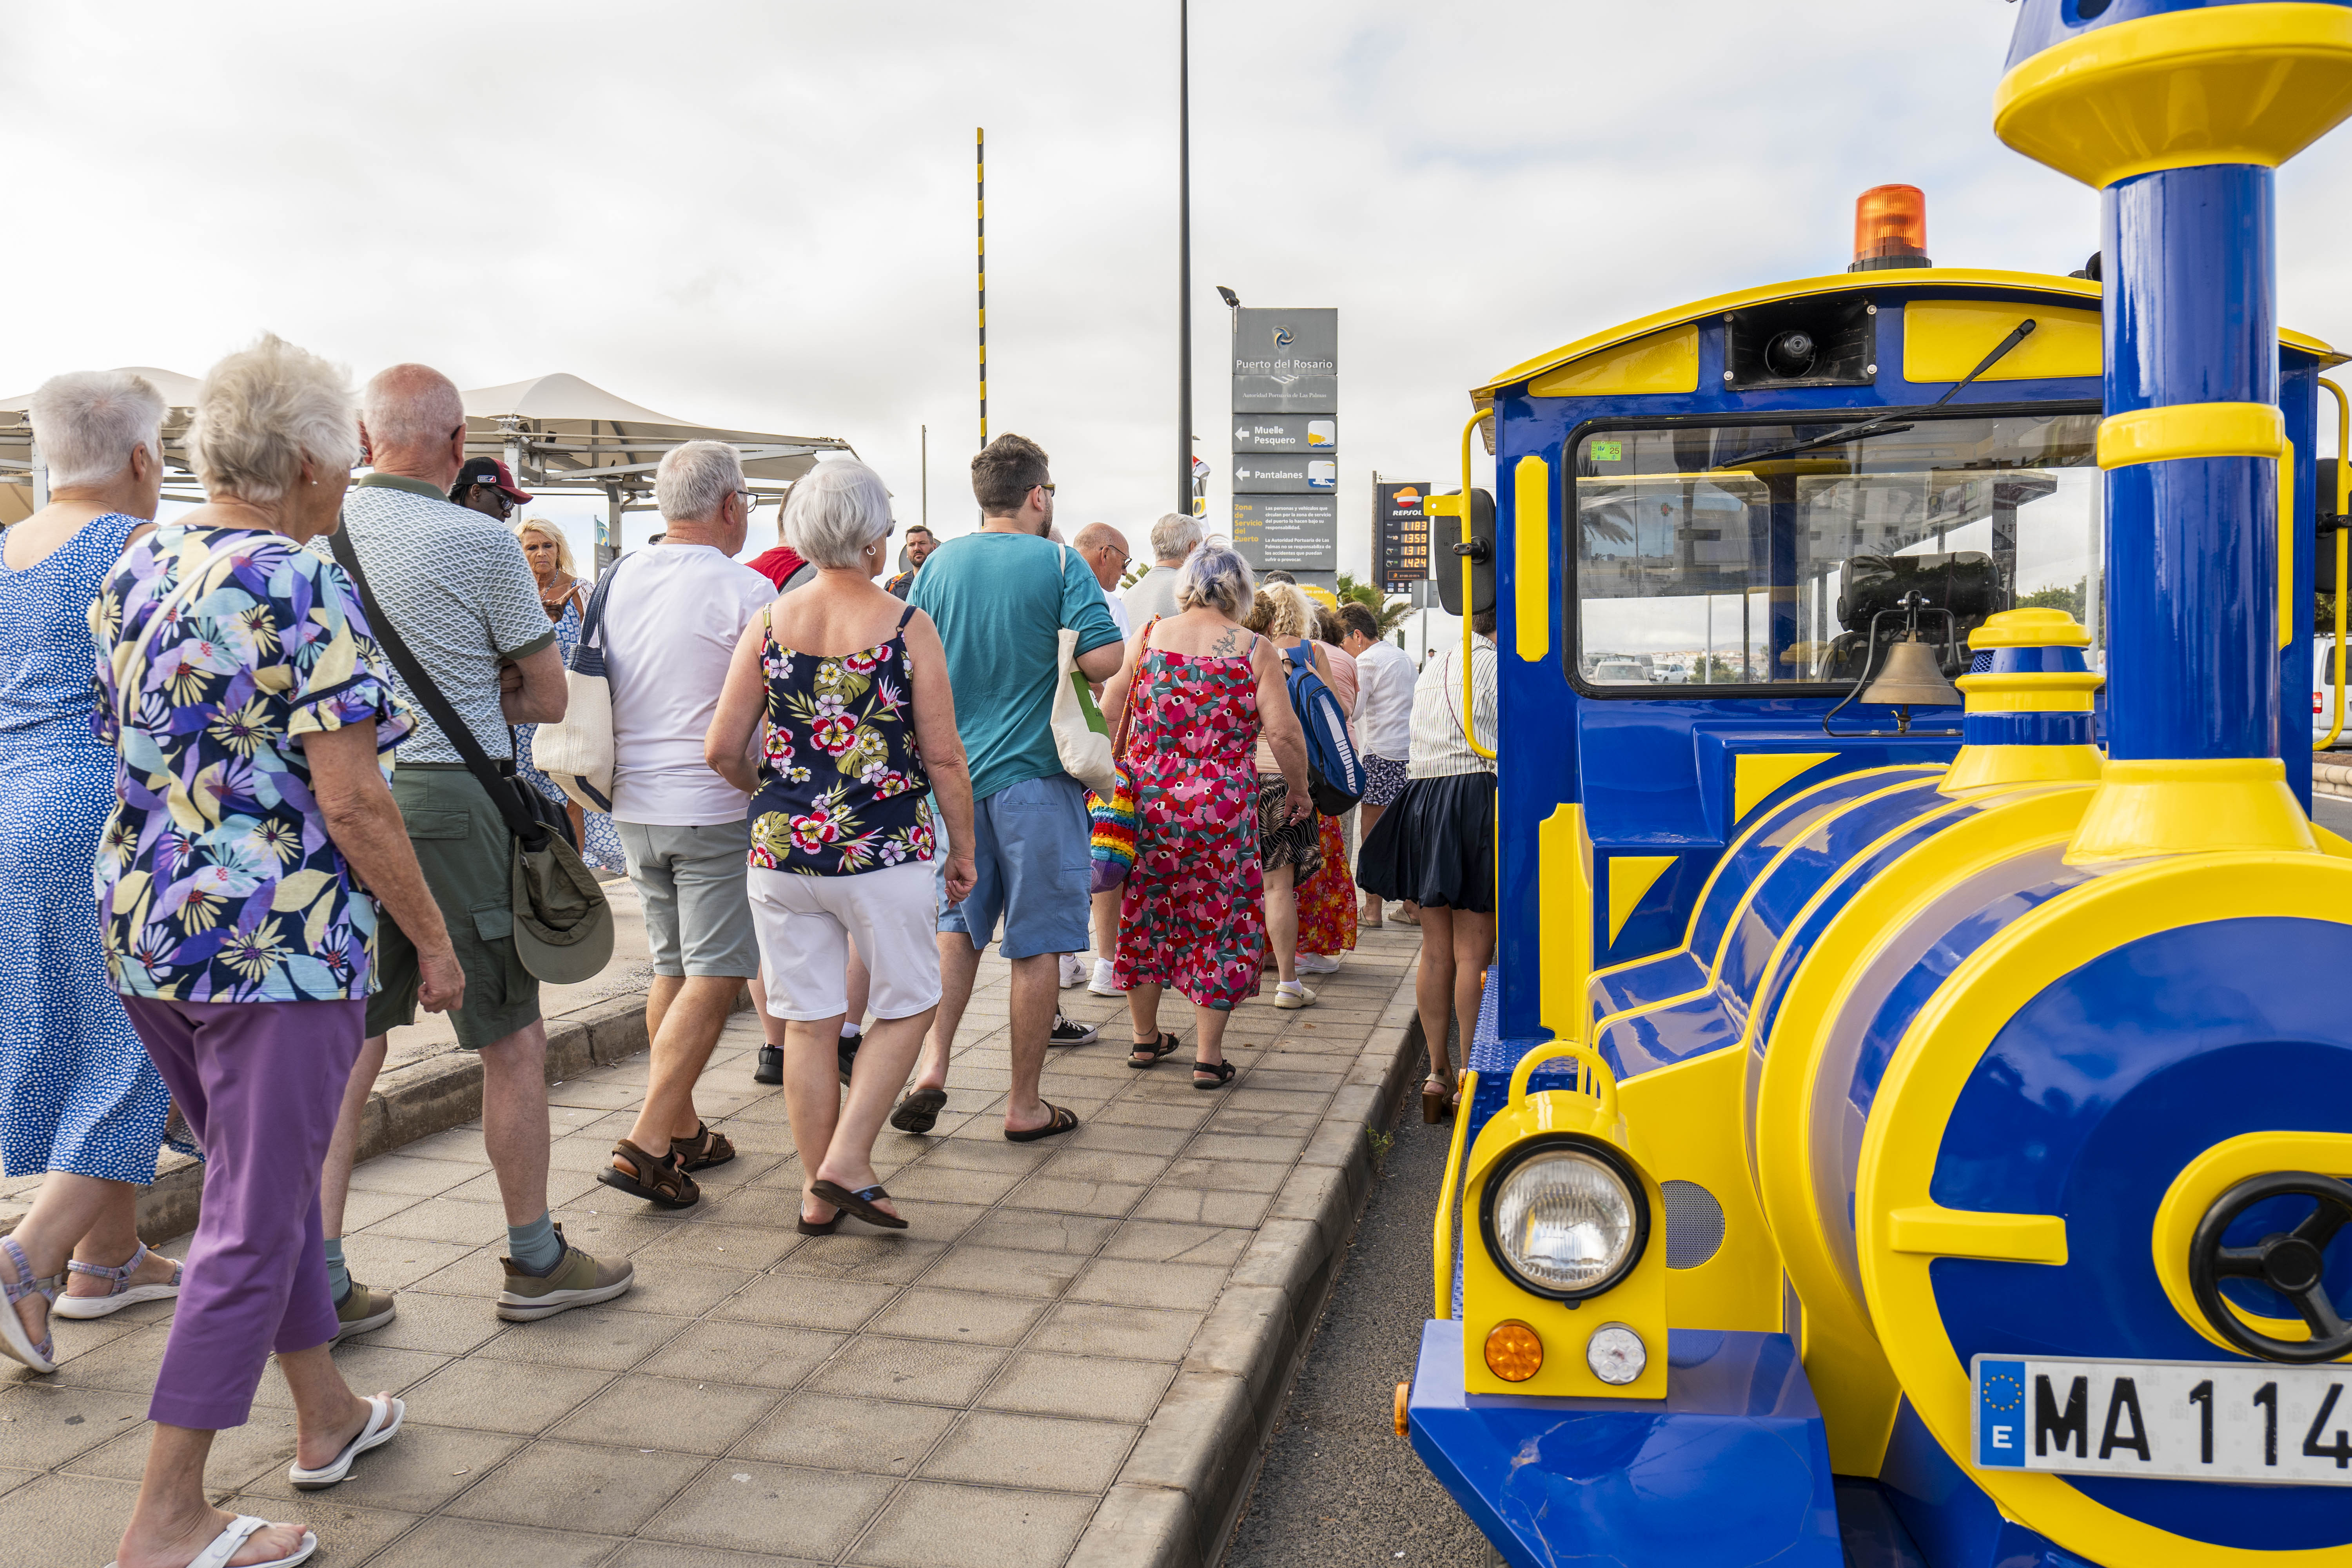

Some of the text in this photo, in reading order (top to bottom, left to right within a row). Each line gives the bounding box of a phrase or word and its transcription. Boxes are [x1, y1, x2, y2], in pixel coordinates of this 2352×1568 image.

[1236, 359, 1332, 368] Puerto del Rosario
[1255, 437, 1296, 445] Pesquero
[1405, 521, 1427, 531] 1.183
[1405, 534, 1427, 543] 1.359
[1404, 546, 1426, 555] 1.319
[1404, 558, 1426, 568] 1.424
[2035, 1374, 2151, 1461] MA
[1993, 1425, 2013, 1448] E
